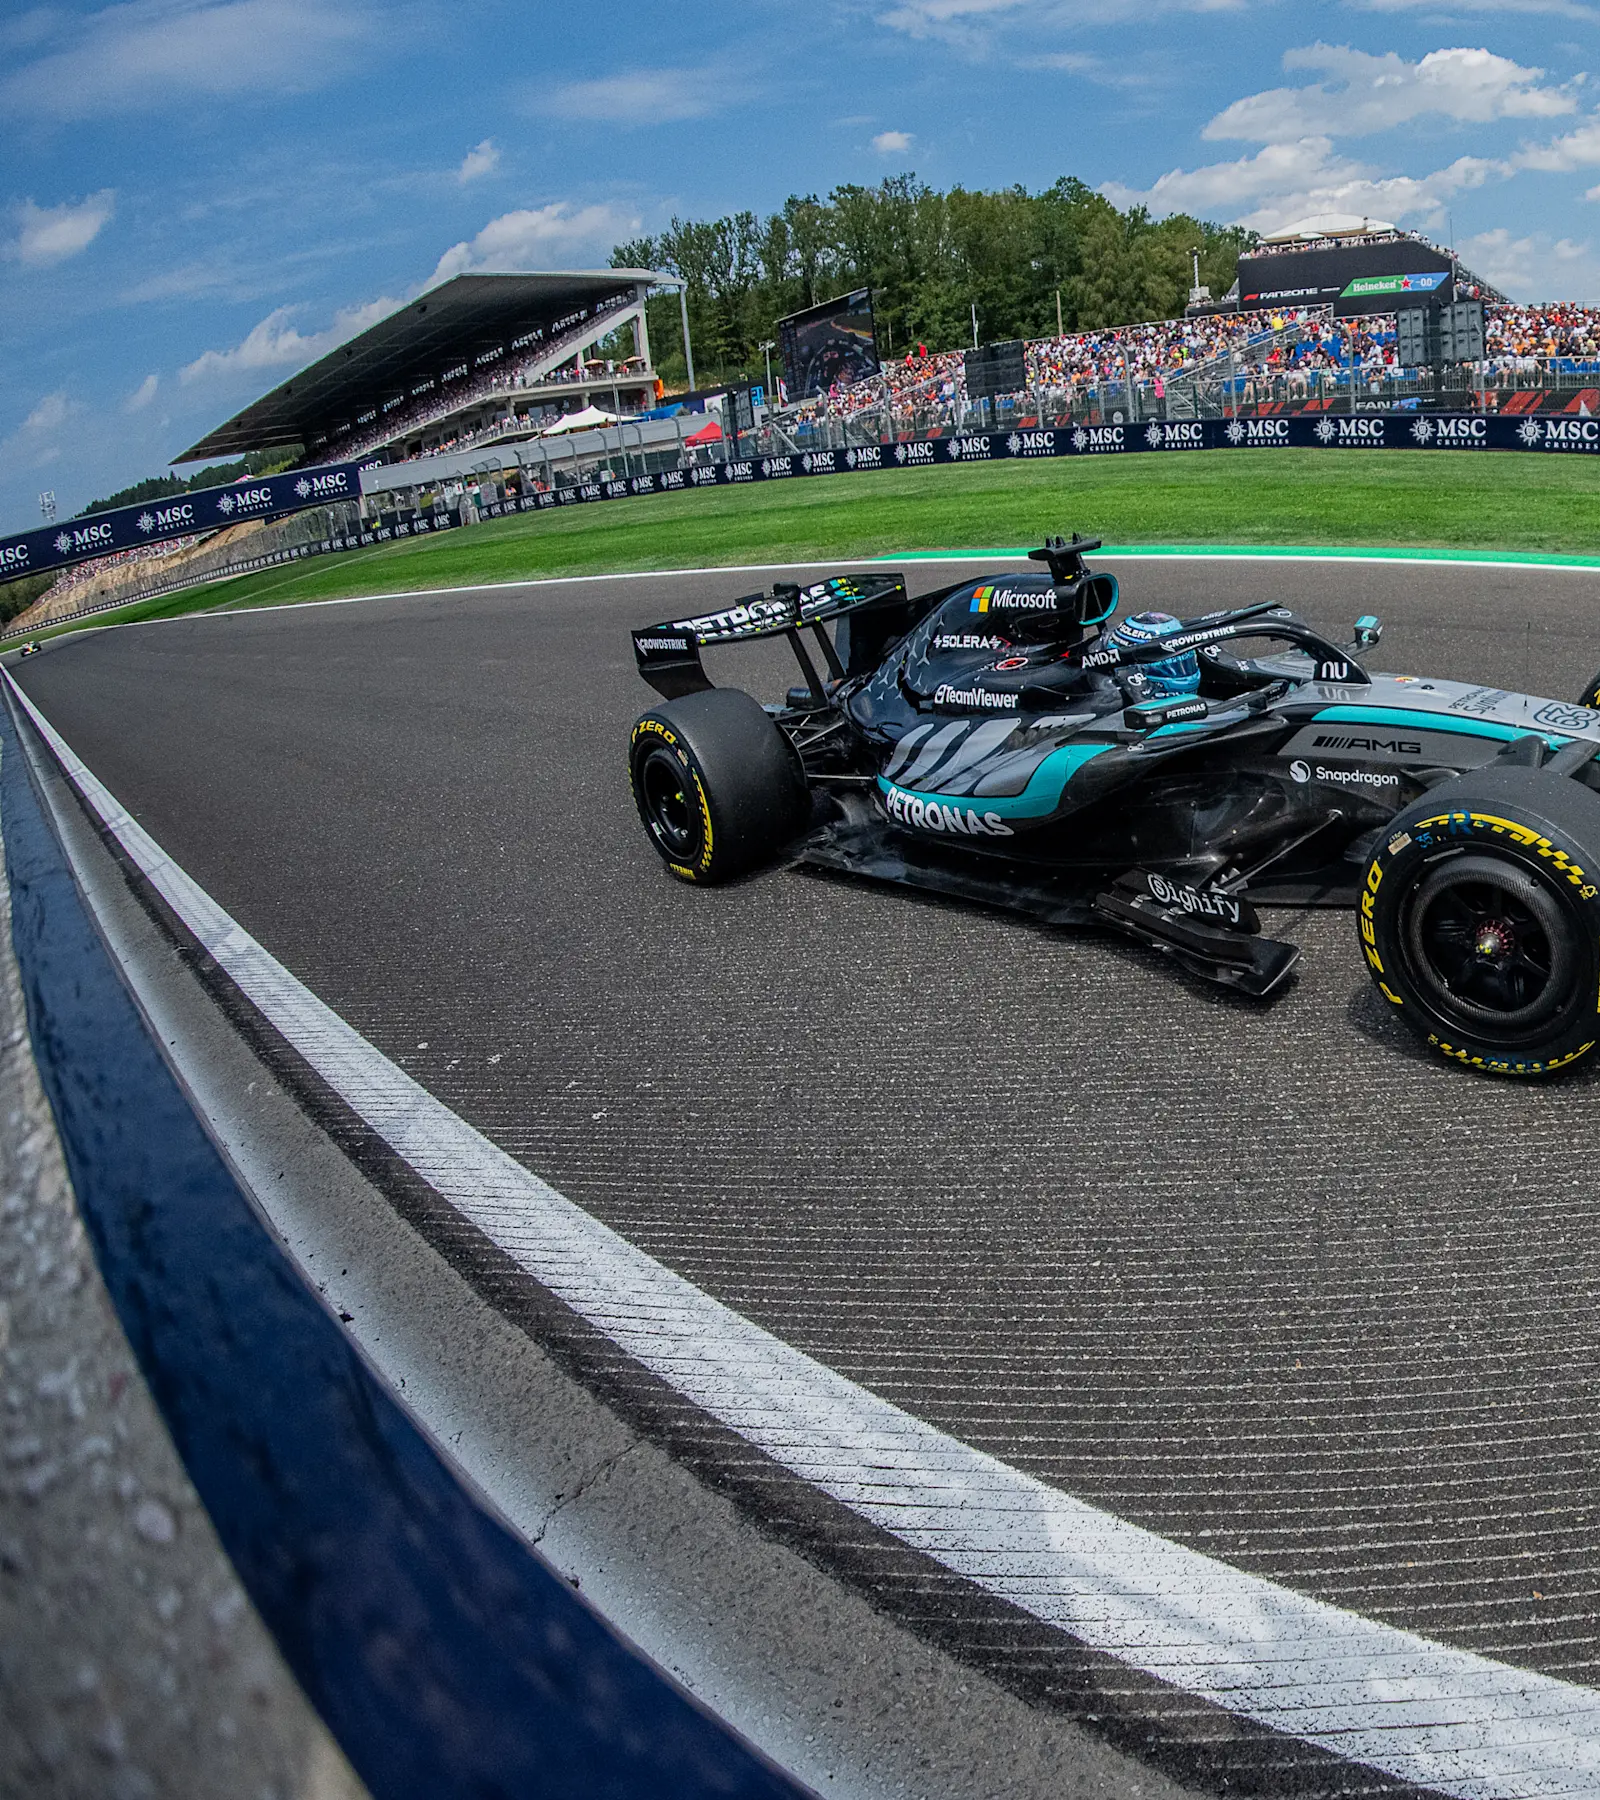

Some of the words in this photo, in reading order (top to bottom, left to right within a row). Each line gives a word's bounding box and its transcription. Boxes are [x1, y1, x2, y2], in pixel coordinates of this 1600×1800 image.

[1260, 287, 1318, 300] FANZONE
[1353, 280, 1396, 292] Heineken
[1089, 426, 1124, 443] MSC
[1164, 423, 1202, 440] MSC
[1248, 420, 1288, 436] MSC
[1338, 419, 1384, 436] MSC
[1436, 419, 1486, 436] MSC
[1545, 420, 1598, 440] MSC
[961, 437, 990, 453] MSC
[1022, 432, 1054, 448] MSC
[1437, 438, 1486, 446] CRUISES
[1545, 442, 1598, 450] CRUISES
[857, 447, 881, 462] MSC
[907, 442, 933, 458] MSC
[772, 457, 792, 471] MSC
[813, 452, 834, 466] MSC
[699, 466, 715, 480] MSC
[734, 462, 752, 475] MSC
[312, 473, 346, 490] MSC
[638, 476, 654, 488] MSC
[668, 471, 683, 483] MSC
[236, 488, 271, 506] MSC
[156, 505, 193, 526] MSC
[73, 524, 112, 545] MSC
[0, 560, 30, 572] UISES
[992, 589, 1057, 609] Microsoft
[1121, 625, 1152, 640] SOLERA
[1166, 626, 1236, 649] CROWDSTRIKE
[639, 638, 688, 650] CROWDSTRIKE
[941, 635, 989, 649] SOLERA
[1082, 652, 1110, 668] AMD
[1322, 661, 1347, 679] nu
[945, 686, 1018, 708] TeamViewer
[1166, 702, 1206, 719] PETRONAS
[1534, 702, 1600, 730] 63
[639, 720, 676, 744] ZERO
[1351, 738, 1421, 754] AMG
[1316, 766, 1399, 786] Snapdragon
[887, 787, 1014, 836] PETRONAS
[1148, 873, 1241, 924] Signify
[1361, 859, 1384, 974] ZERO
